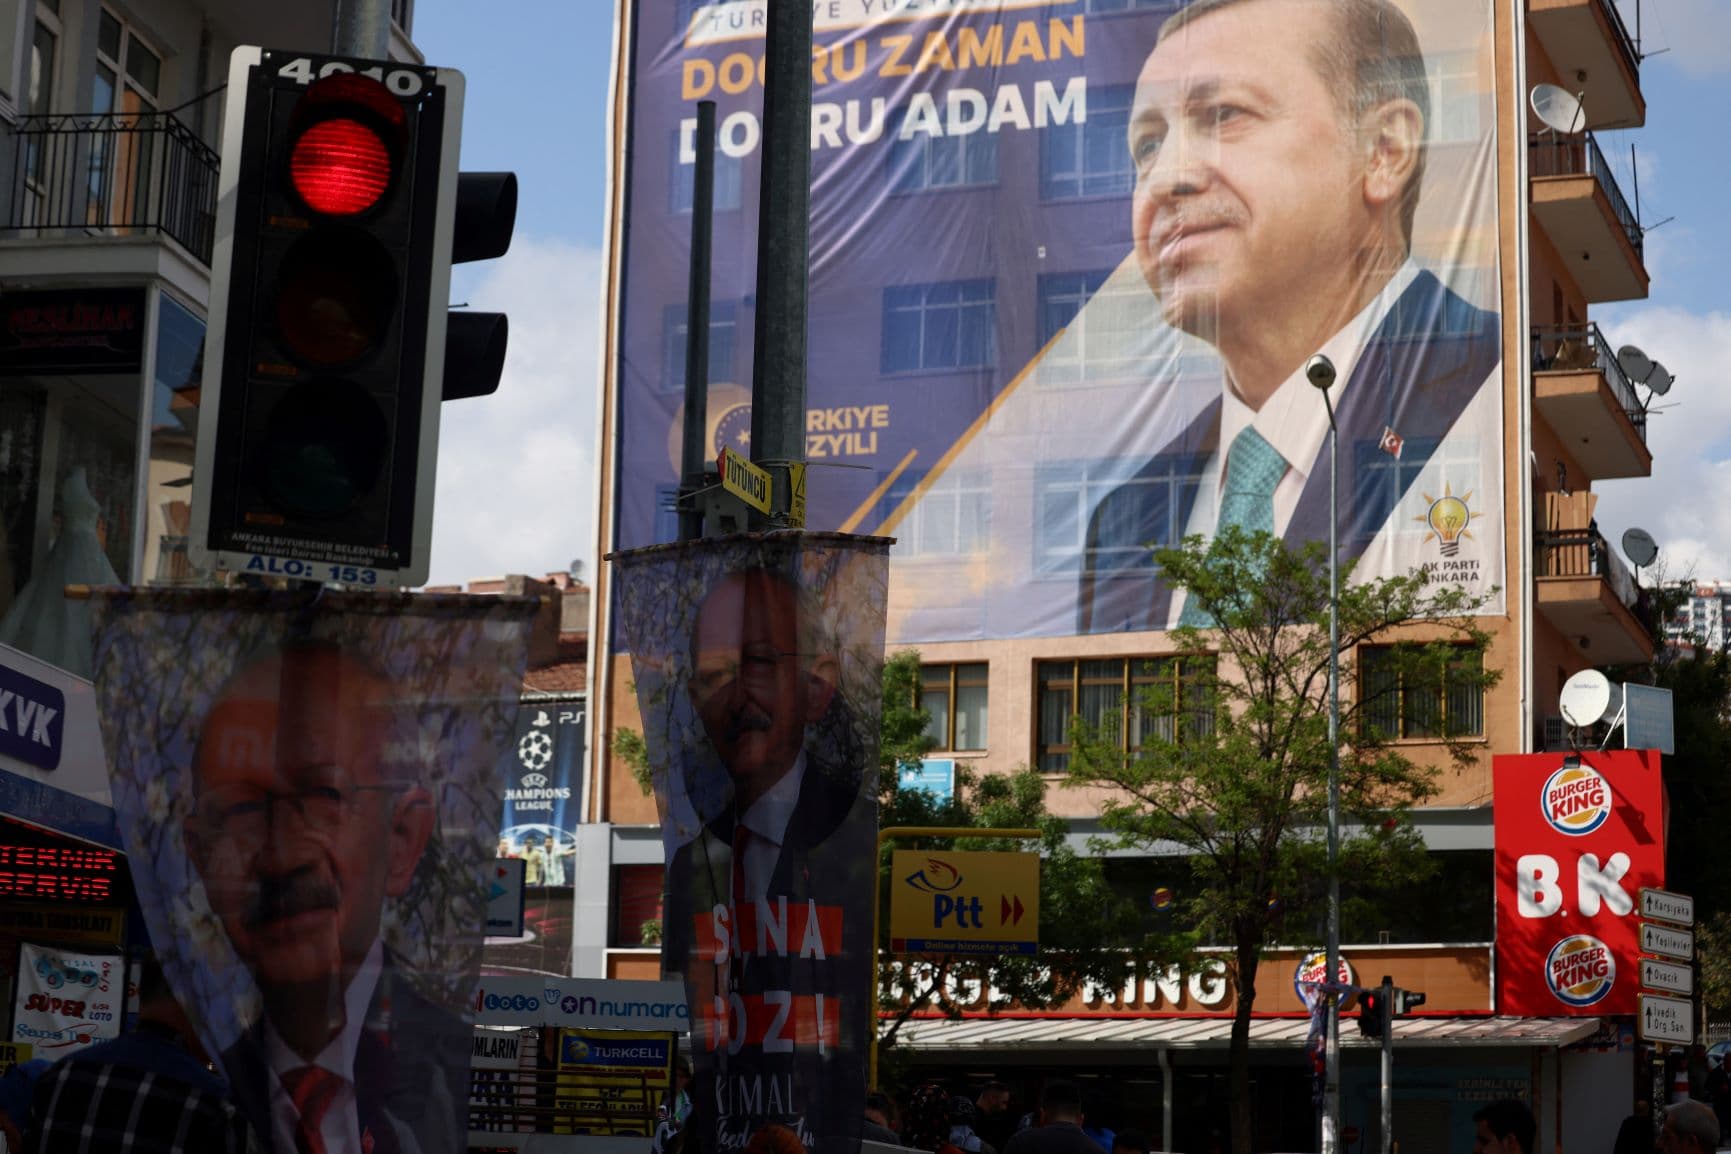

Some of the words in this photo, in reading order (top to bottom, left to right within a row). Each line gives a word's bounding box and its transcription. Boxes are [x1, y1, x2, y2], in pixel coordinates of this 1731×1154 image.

[681, 38, 868, 101] DORU
[878, 14, 1086, 77] ZAMAN
[679, 97, 886, 165] DORU
[898, 75, 1088, 141] ADAM
[726, 454, 766, 504] TÜTÜNCÜ
[247, 555, 313, 577] ALO:
[328, 565, 377, 585] 153
[1421, 562, 1439, 573] AK
[1430, 571, 1480, 584] NKARA
[1549, 777, 1602, 804] BURGER
[1552, 788, 1605, 821] KING
[934, 893, 984, 929] Ptt
[1553, 947, 1605, 974] BURGER
[1556, 959, 1609, 992] KING
[1081, 958, 1227, 1005] KING
[89, 1011, 113, 1023] LOTO
[608, 1002, 689, 1018] numara
[594, 1046, 664, 1060] TURKCELL
